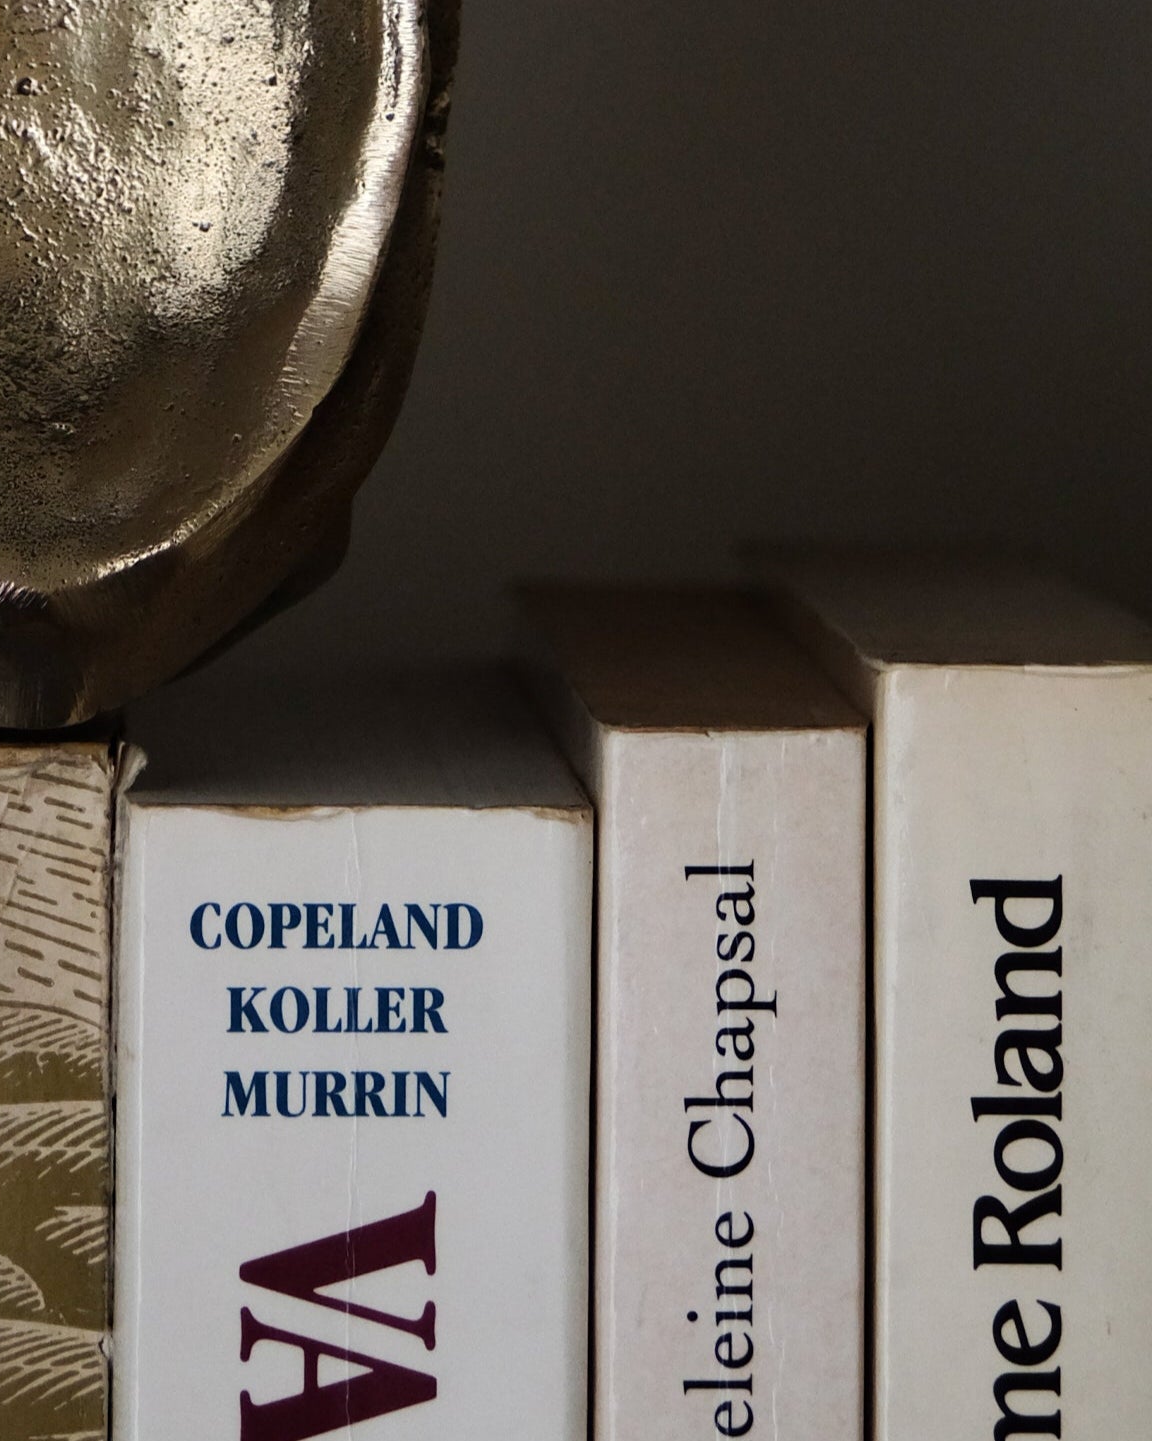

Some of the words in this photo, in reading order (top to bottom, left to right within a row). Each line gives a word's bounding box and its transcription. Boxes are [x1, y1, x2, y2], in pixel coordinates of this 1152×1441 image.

[189, 902, 484, 951] COPELAND
[226, 986, 449, 1035] KOLLER
[684, 859, 778, 1179] Chapsal
[221, 1071, 451, 1118] MURRIN
[969, 874, 1064, 1271] Roland
[238, 1190, 438, 1441] VA
[682, 1211, 755, 1439] eleine
